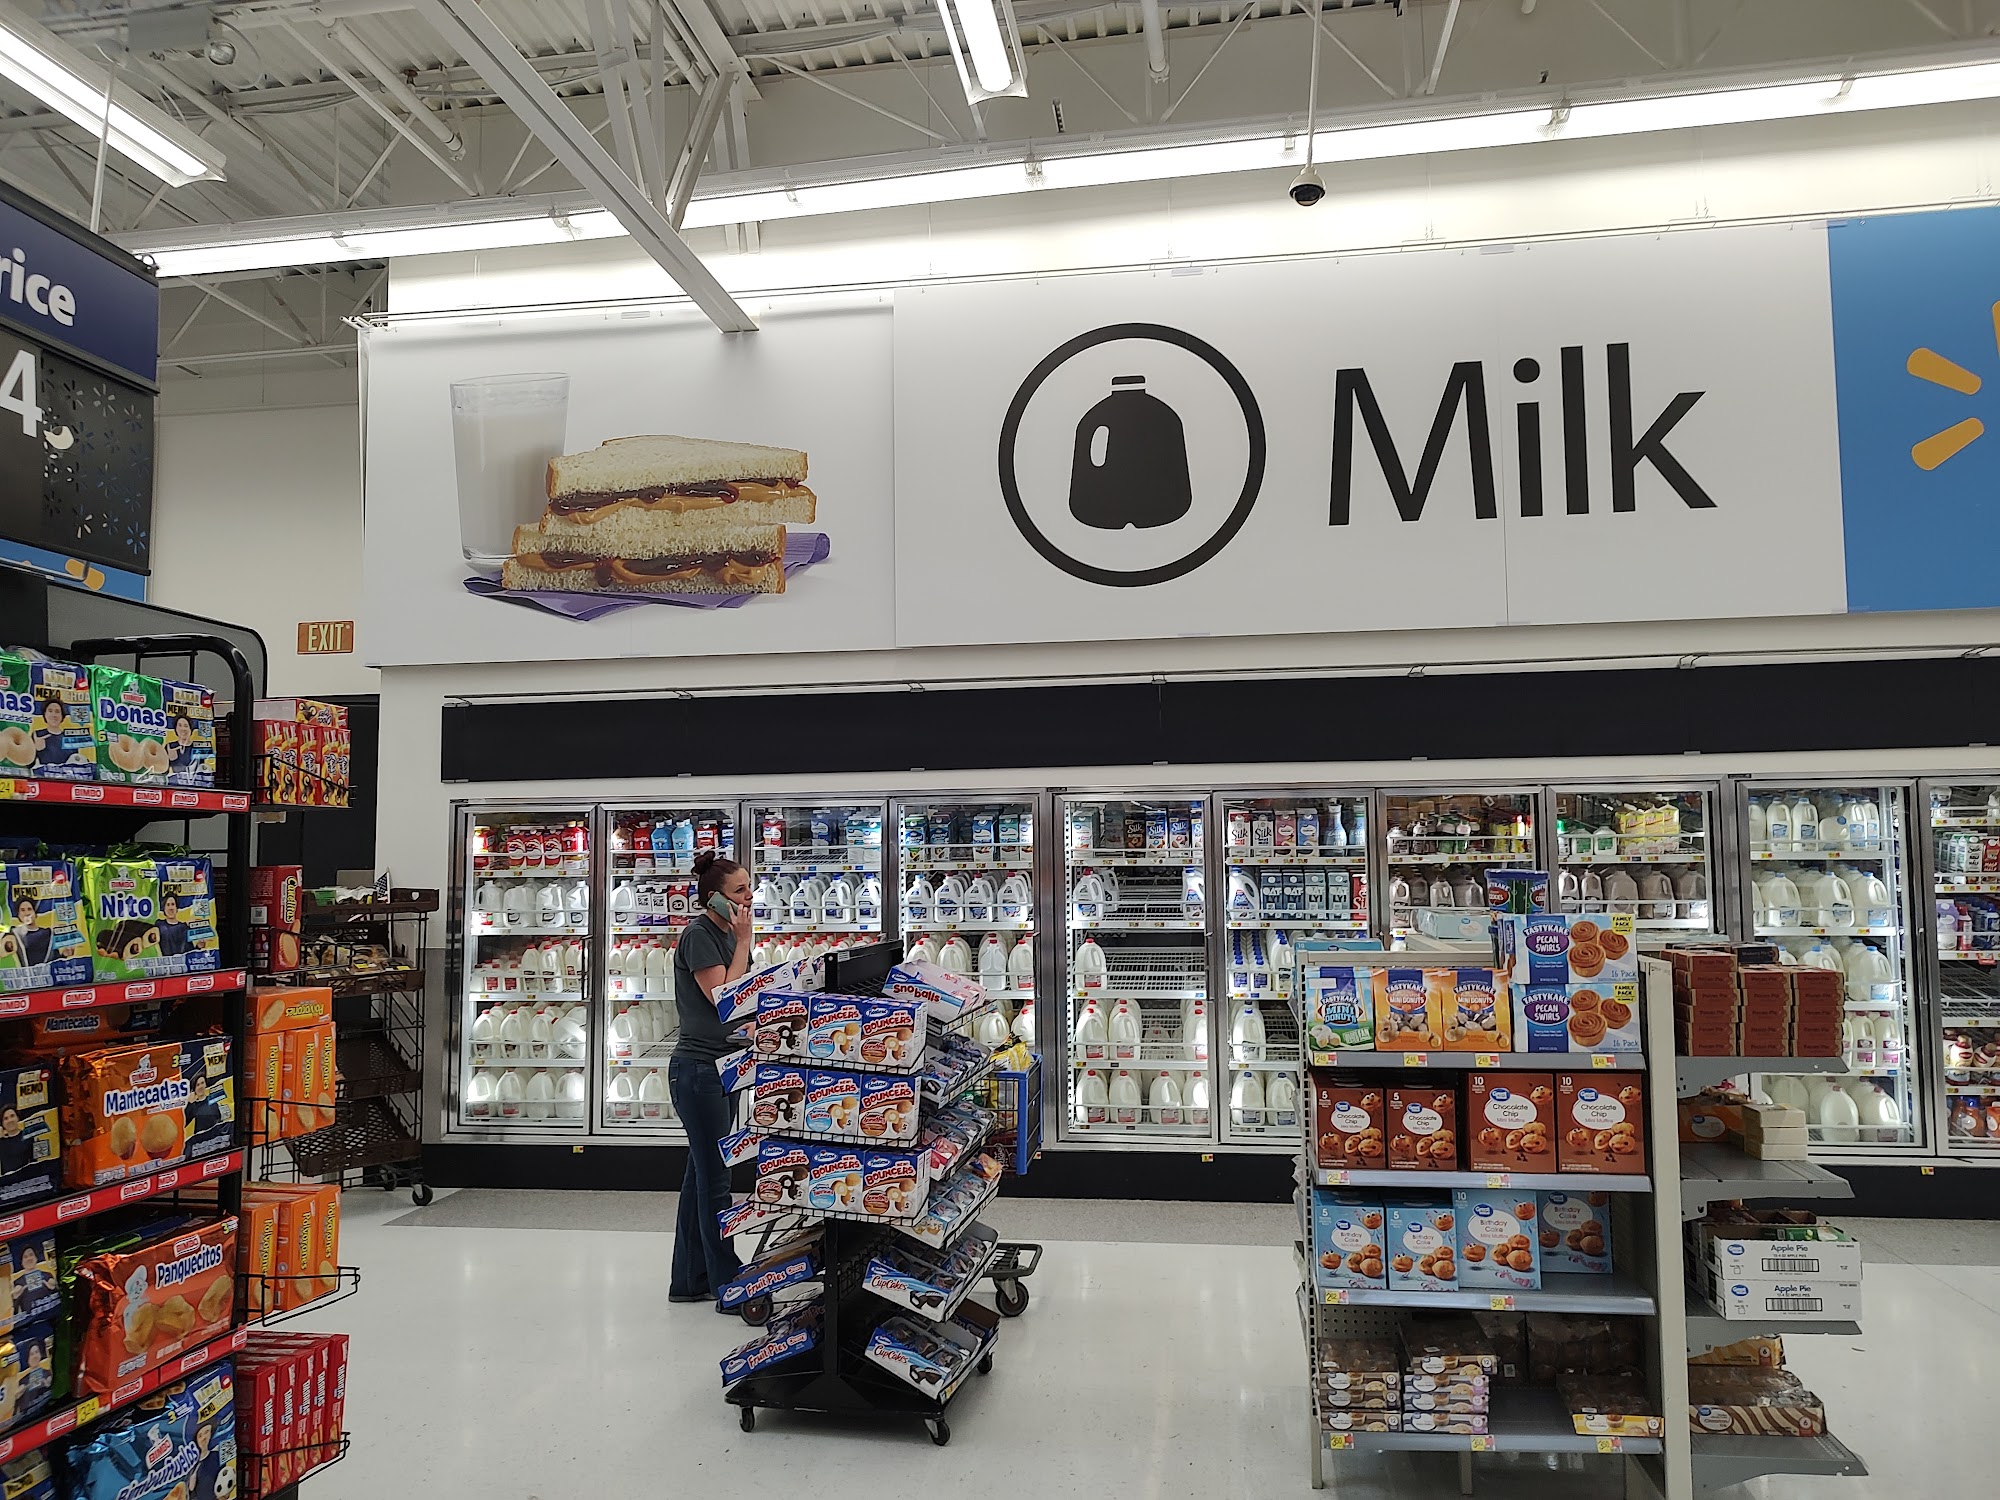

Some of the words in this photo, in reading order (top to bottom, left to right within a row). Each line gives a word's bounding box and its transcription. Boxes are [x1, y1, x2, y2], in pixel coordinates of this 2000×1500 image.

[0, 350, 43, 438] 4
[1329, 342, 1718, 526] Milk
[308, 623, 345, 651] EXIT
[123, 693, 144, 703] BIMBO
[100, 698, 165, 727] Donas
[74, 788, 101, 798] BIMBO
[136, 791, 160, 801] BIMBO
[174, 794, 197, 804] BIMBO
[224, 797, 246, 807] BIMBO
[1127, 824, 1142, 833] Silk
[1148, 825, 1164, 835] Silk
[1171, 822, 1186, 832] Silk
[1255, 827, 1271, 839] Silk
[1232, 829, 1248, 840] Silk
[111, 881, 135, 889] BIMBO
[13, 886, 38, 898] MEMO
[101, 891, 152, 918] Nito
[286, 876, 298, 923] Canelitas
[1524, 924, 1570, 936] TASTYKAKE
[1536, 936, 1559, 944] PECAN
[1535, 943, 1561, 952] SWIRLS
[190, 979, 212, 988] BIMBO
[734, 973, 775, 1006] donettes
[1386, 984, 1427, 994] TASTYKAKE
[1454, 984, 1496, 994] TASTYKAKE
[127, 985, 153, 995] BIMBO
[66, 991, 93, 1004] BIMBO
[1321, 995, 1358, 1005] TASTYKAKE
[1523, 994, 1570, 1004] TASTYKAKE
[285, 1003, 324, 1018] Polvorones
[1326, 1005, 1355, 1015] MINI
[1535, 1004, 1559, 1012] PECAN
[759, 1006, 806, 1024] BOUNCERS
[811, 1011, 860, 1029] BOUNCERS
[1534, 1012, 1561, 1021] SWIRLS
[46, 1014, 99, 1032] Mantecadas
[863, 1016, 912, 1034] BOUNCERS
[171, 1056, 179, 1067] 3
[323, 1036, 333, 1090] Polvorones
[303, 1042, 315, 1099] Polvorones
[1474, 1077, 1484, 1085] 10
[1562, 1077, 1572, 1085] 10
[756, 1078, 803, 1097] BOUNCERS
[808, 1084, 857, 1103] BOUNCERS
[105, 1079, 188, 1115] Mantecadas
[863, 1089, 912, 1107] BOUNCERS
[1321, 1091, 1327, 1099] 5
[1393, 1093, 1400, 1101] 5
[1492, 1103, 1529, 1111] Chocolate
[1580, 1103, 1617, 1111] Chocolate
[205, 1159, 226, 1172] BIMBO
[760, 1155, 808, 1173] BOUNCERS
[812, 1160, 860, 1178] BOUNCERS
[865, 1167, 914, 1185] BOUNCERS
[123, 1182, 148, 1197] BIMBO
[1457, 1192, 1467, 1200] 10
[60, 1199, 88, 1215] BIMBO
[1322, 1209, 1328, 1217] 5
[1554, 1206, 1581, 1214] Birthday
[1394, 1211, 1400, 1219] 5
[222, 1222, 229, 1234] 3
[1480, 1219, 1508, 1227] Birthday
[325, 1202, 336, 1259] Polvorones
[299, 1213, 311, 1270] Polvorones
[1771, 1244, 1795, 1252] Apple
[157, 1245, 222, 1288] Panquecitos
[746, 1276, 767, 1298] Fruit
[766, 1271, 786, 1285] Pies
[871, 1275, 908, 1291] CupCakes
[1774, 1285, 1798, 1293] Apple
[747, 1347, 768, 1369] Fruit
[768, 1343, 788, 1356] Pies
[874, 1345, 909, 1364] CupCakes
[114, 1380, 141, 1399] BIMBO
[168, 1412, 176, 1424] 3
[148, 1439, 171, 1462] BIMBO
